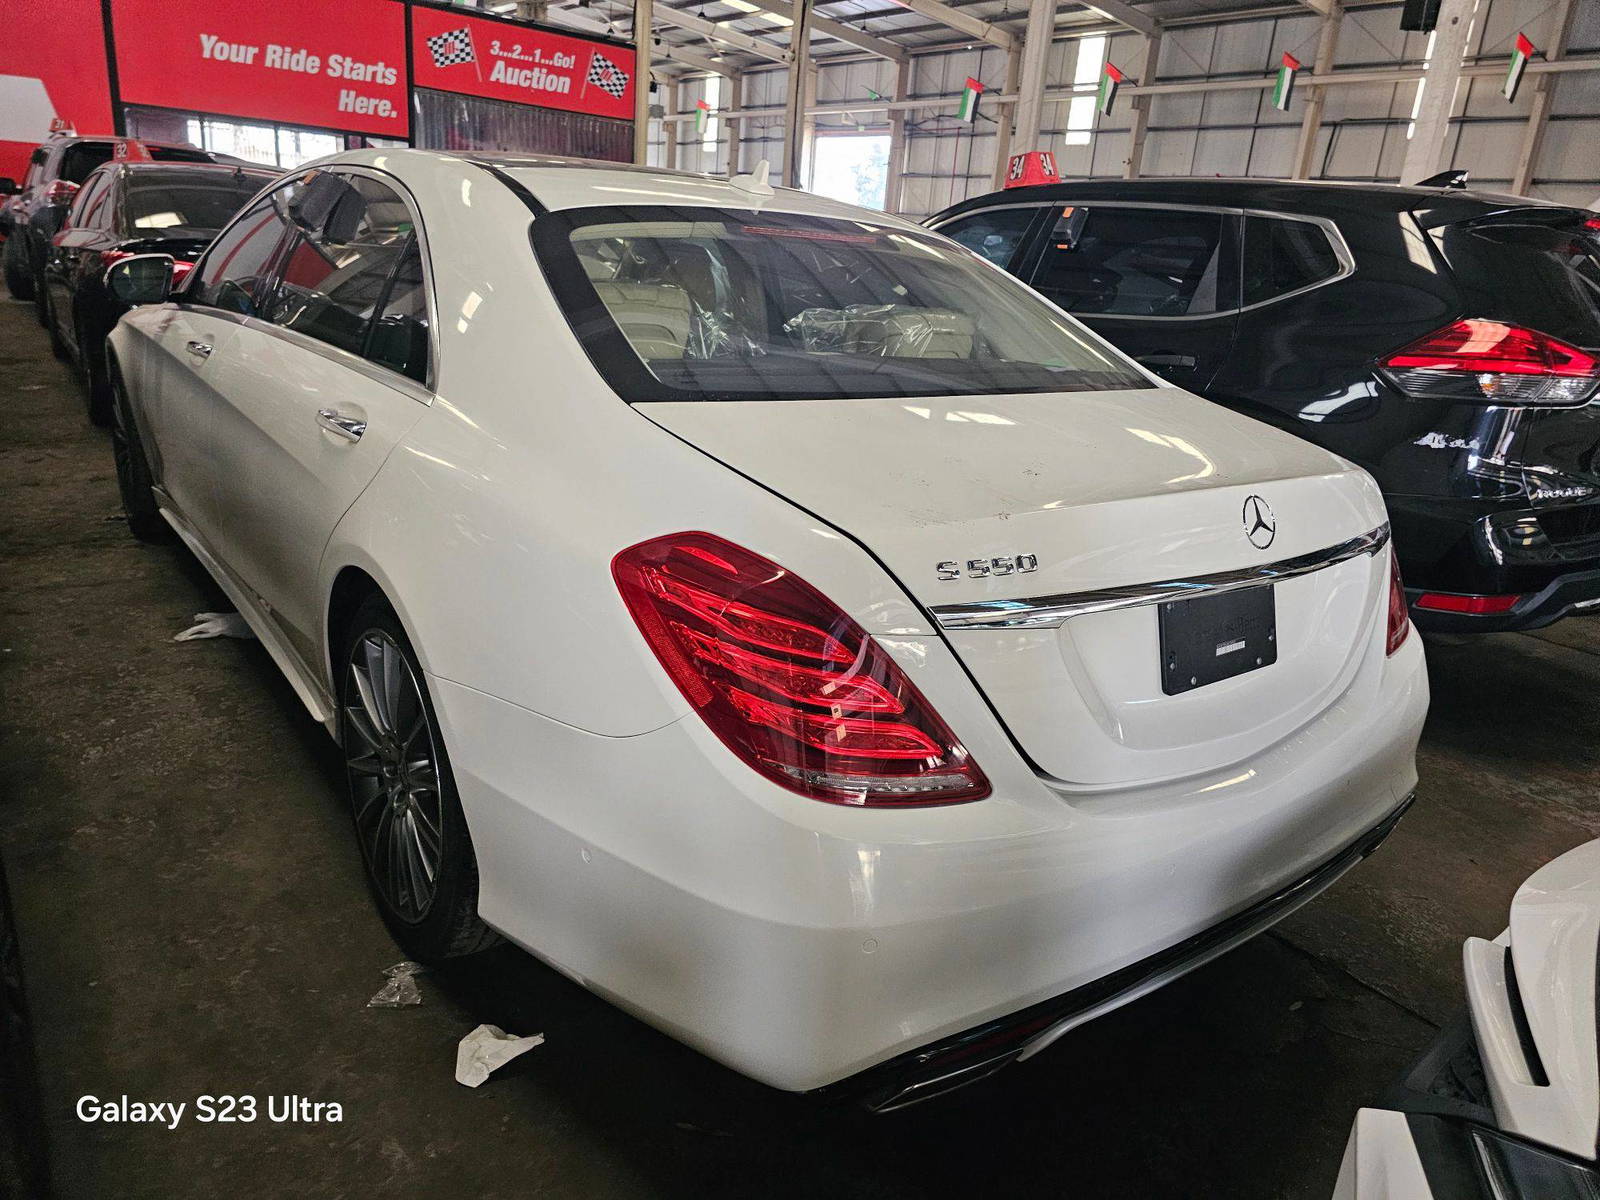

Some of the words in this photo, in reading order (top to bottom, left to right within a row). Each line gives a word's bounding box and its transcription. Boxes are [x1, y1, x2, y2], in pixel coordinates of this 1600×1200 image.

[200, 33, 259, 65] Your
[264, 44, 321, 74] Ride
[326, 54, 398, 86] Starts
[489, 60, 571, 95] Auction
[338, 89, 398, 119] Here.
[116, 143, 127, 158] 32
[1010, 155, 1025, 180] 34
[1040, 153, 1054, 176] 34
[1536, 486, 1587, 500] ROGUE
[936, 561, 961, 581] S
[966, 554, 1038, 579] 550
